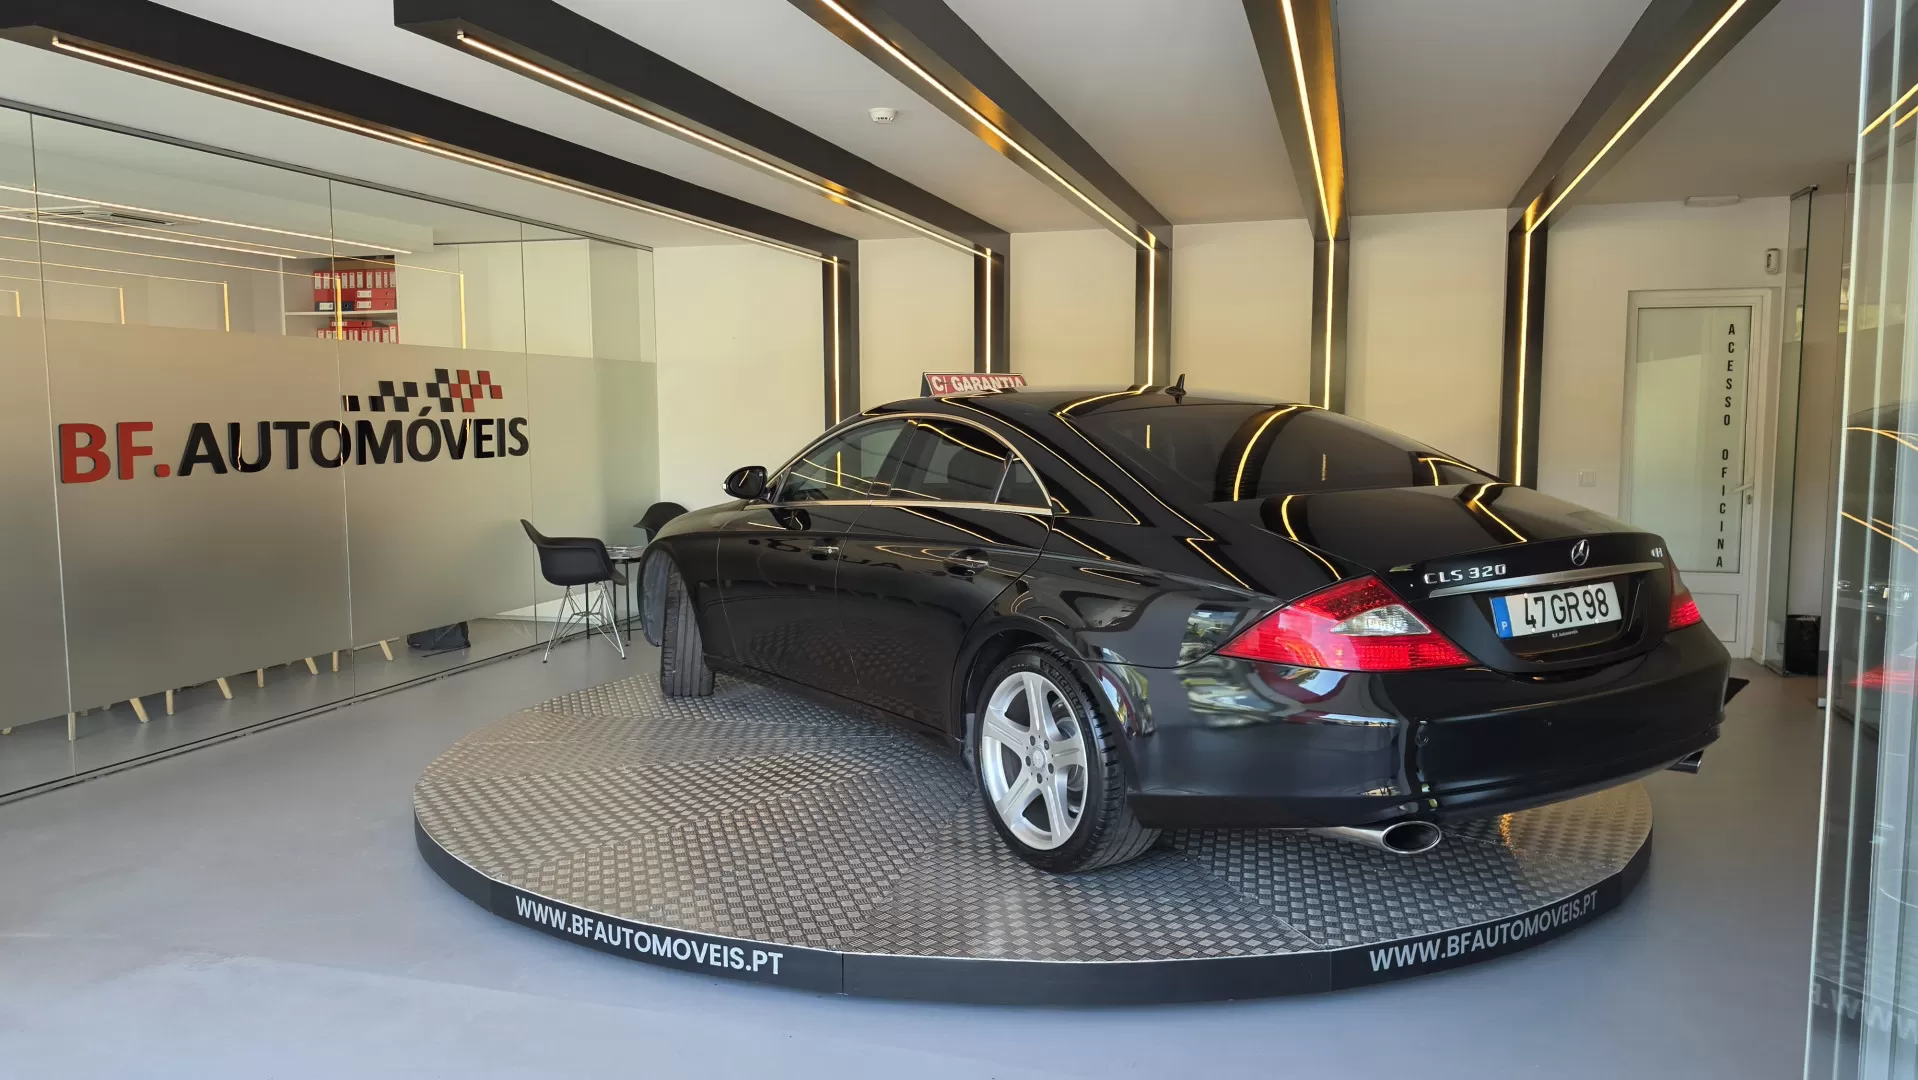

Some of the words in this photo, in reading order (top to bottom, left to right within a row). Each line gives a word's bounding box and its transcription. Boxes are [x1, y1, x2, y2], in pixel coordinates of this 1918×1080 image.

[950, 376, 1024, 392] GARANTIA
[1723, 323, 1736, 426] ACESSO
[1715, 448, 1729, 568] OFICINA
[1423, 569, 1463, 585] CLS
[1468, 563, 1507, 580] 320
[1501, 621, 1508, 631] P
[515, 895, 784, 975] WWW.BFAUTOMOVEIS.PT
[1369, 890, 1598, 971] WWW.BFAUTOMOVEIS.PT
